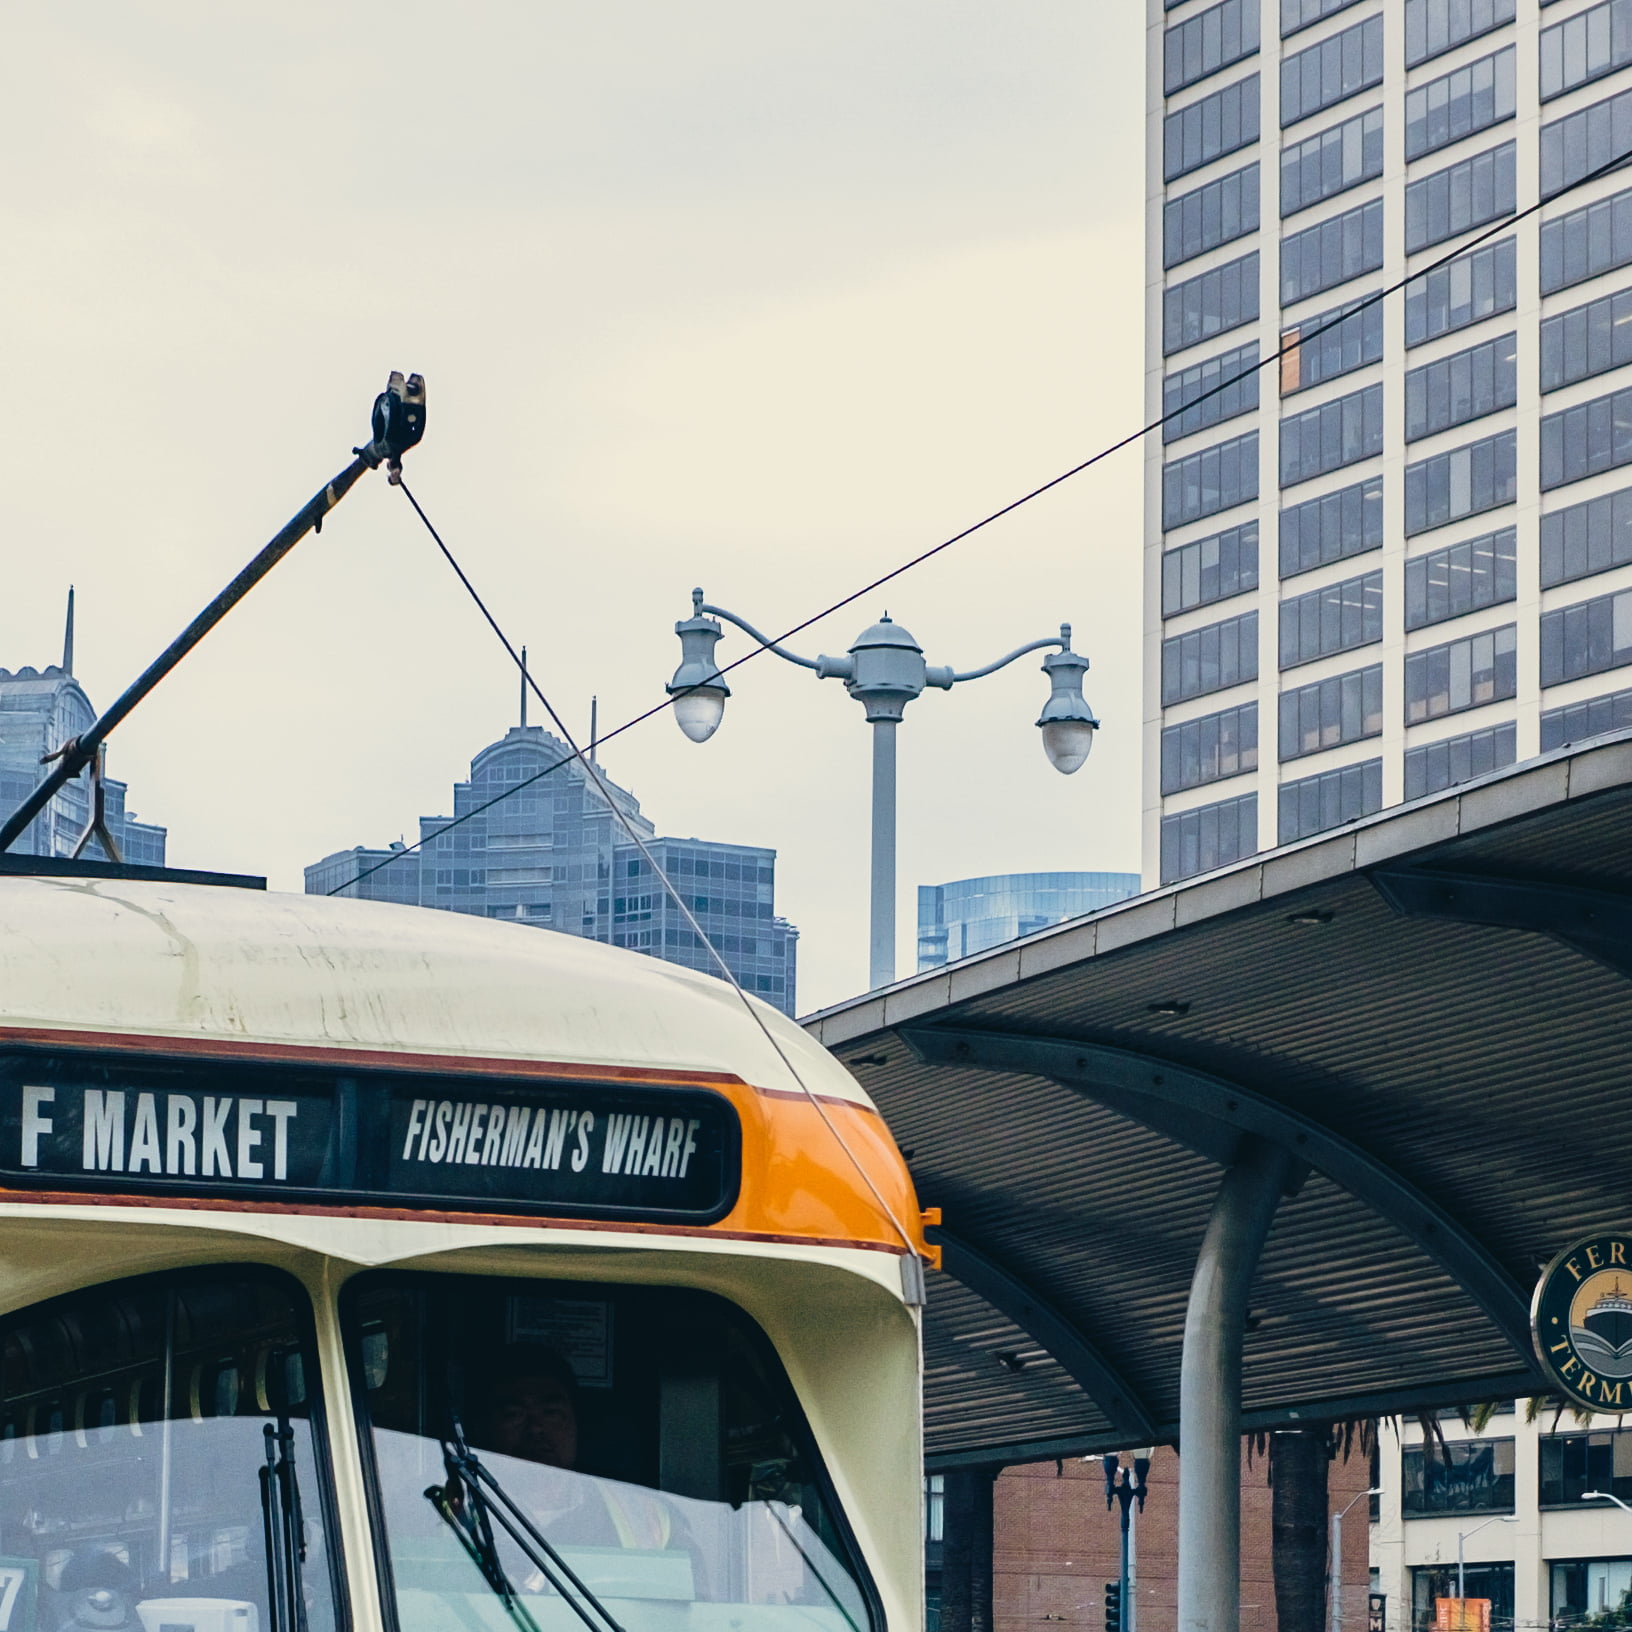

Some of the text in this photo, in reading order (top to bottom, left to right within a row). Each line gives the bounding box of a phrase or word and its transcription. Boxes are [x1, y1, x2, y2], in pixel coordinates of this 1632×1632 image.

[21, 1085, 297, 1181] F MARKET
[402, 1099, 700, 1178] FISHERMAN'S WHARF
